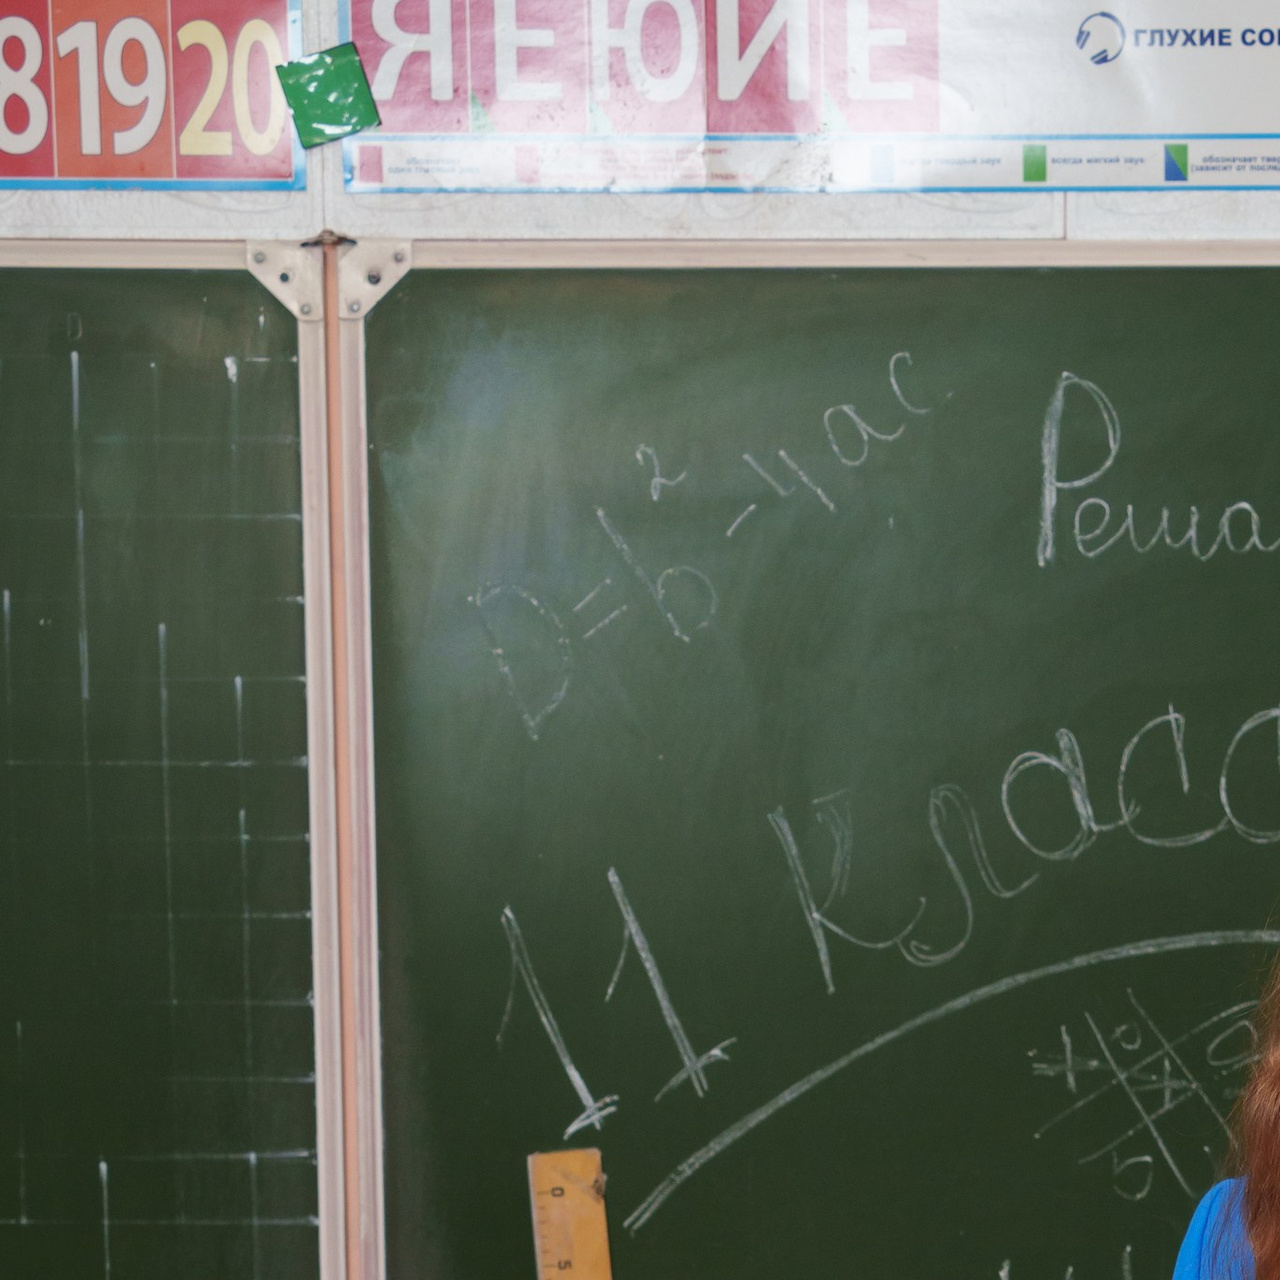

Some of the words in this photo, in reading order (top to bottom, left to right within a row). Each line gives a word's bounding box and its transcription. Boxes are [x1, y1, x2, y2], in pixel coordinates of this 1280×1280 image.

[1132, 28, 1233, 48] ГЛУХИЕ
[56, 16, 167, 156] 19
[176, 18, 288, 156] 20
